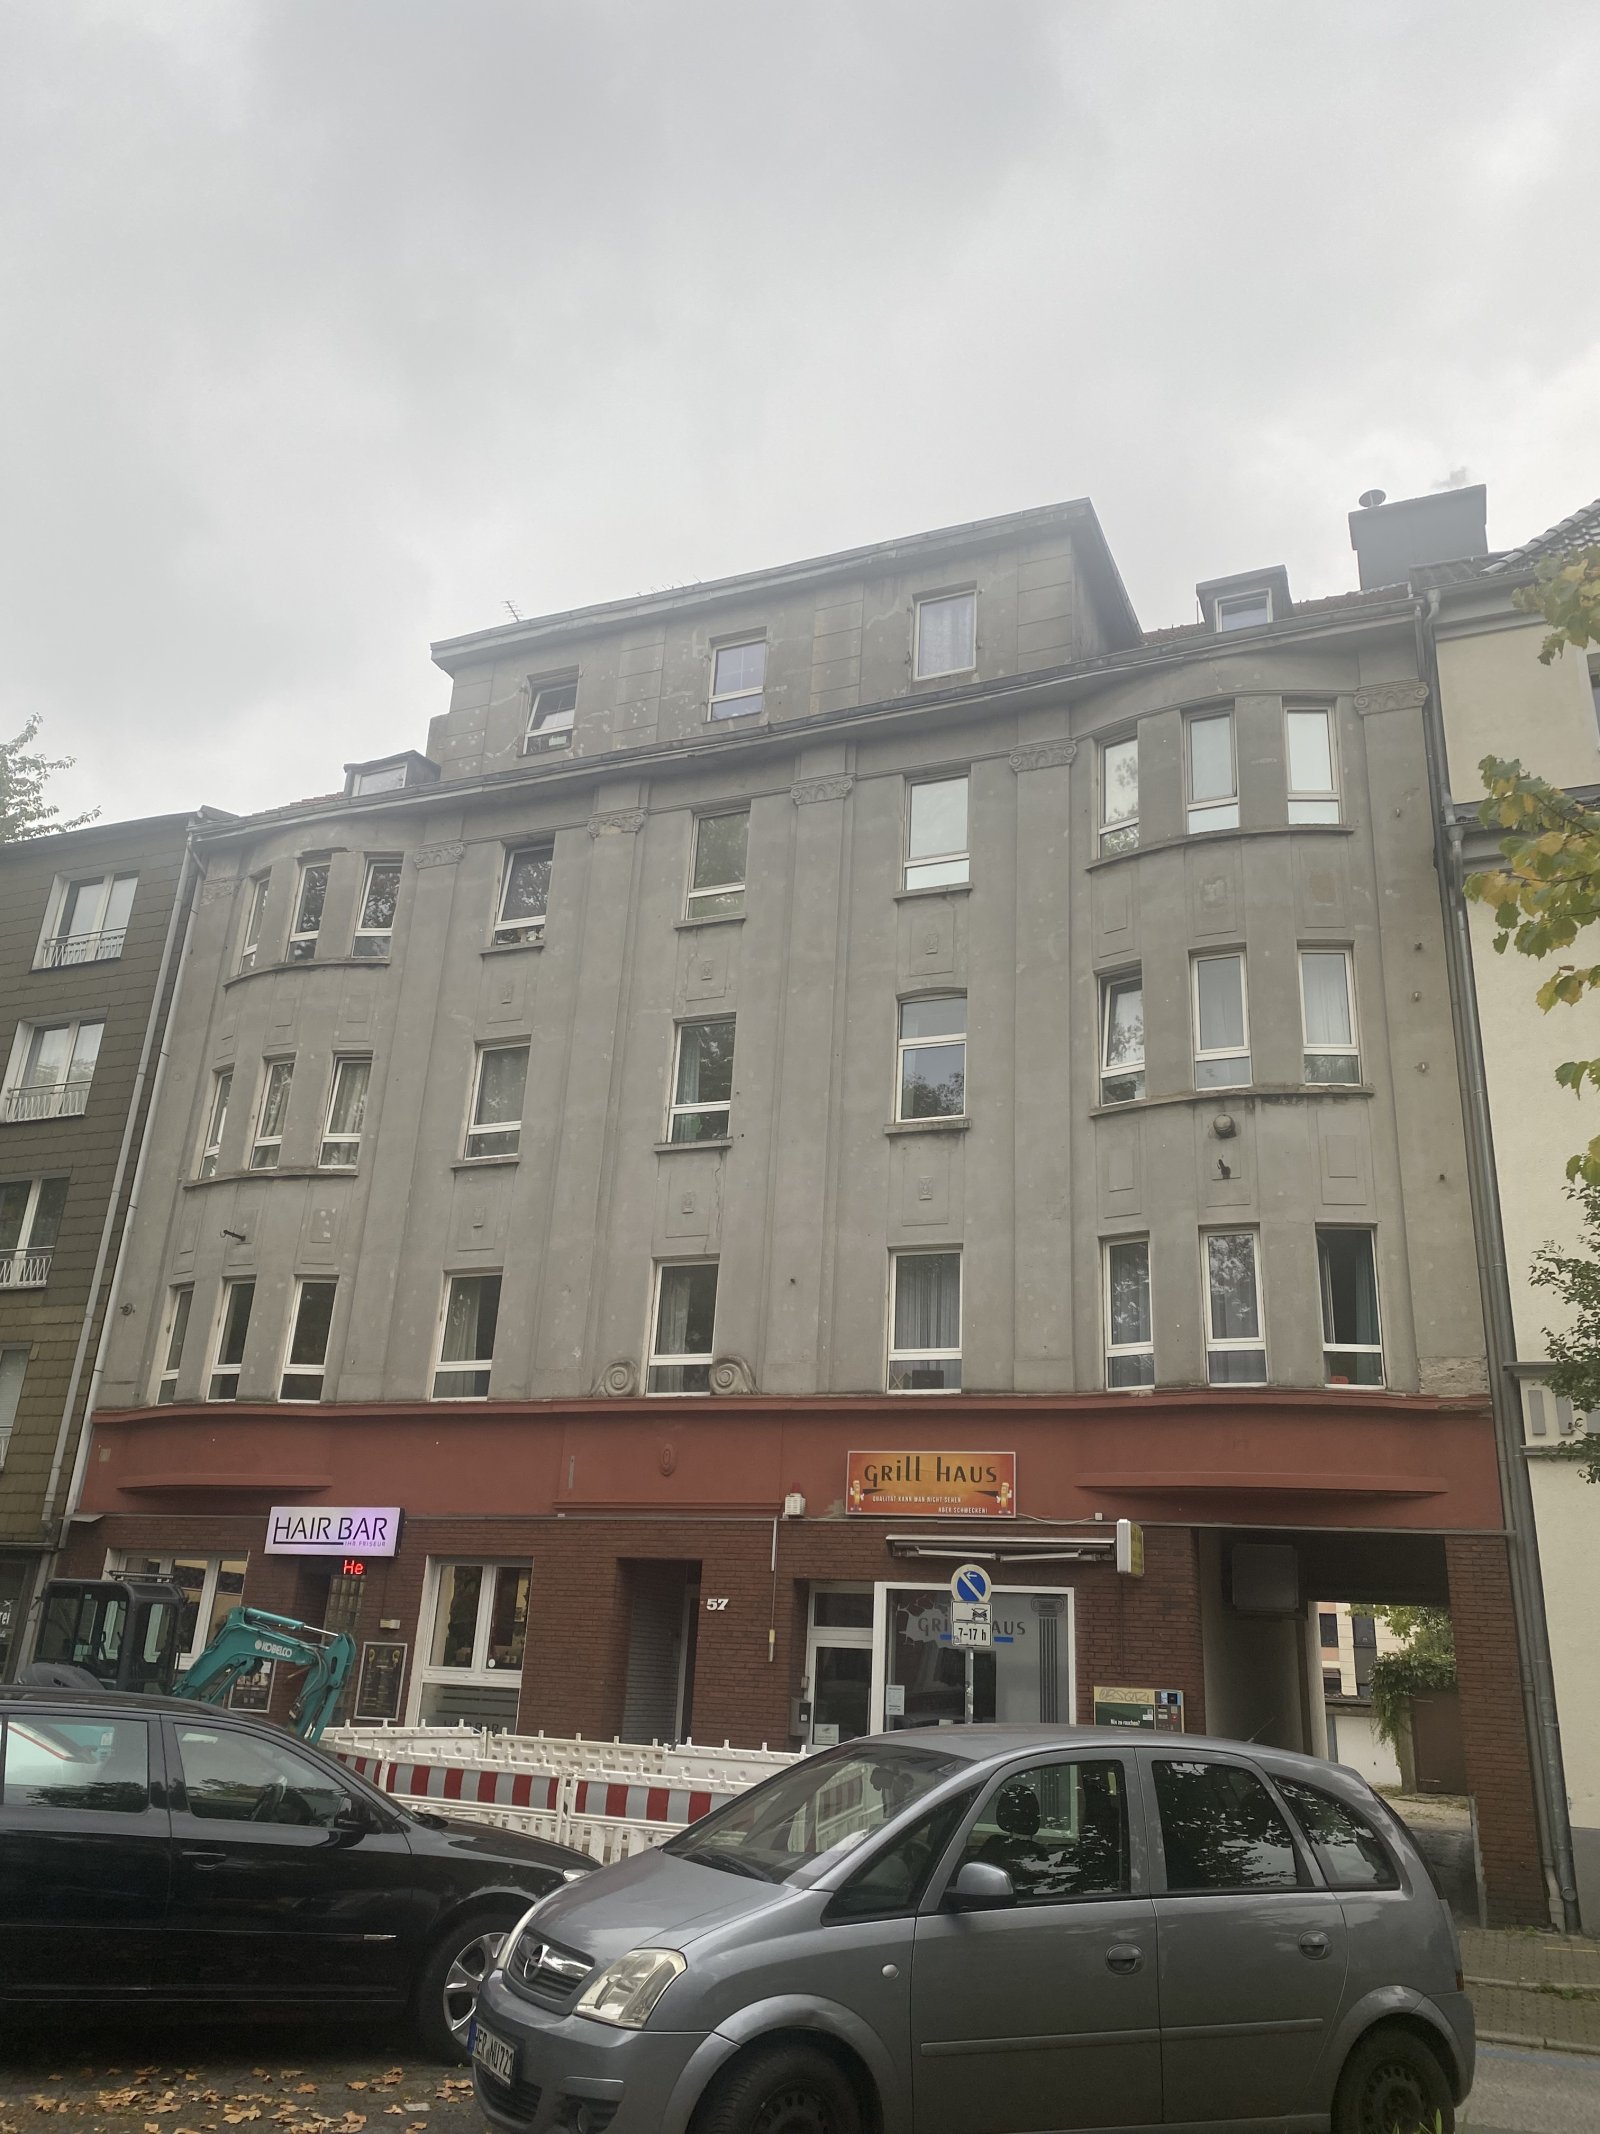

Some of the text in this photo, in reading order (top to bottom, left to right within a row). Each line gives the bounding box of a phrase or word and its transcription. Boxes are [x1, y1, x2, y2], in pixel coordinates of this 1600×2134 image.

[273, 1517, 388, 1544] HAIR BAR
[343, 1560, 364, 1575] He
[706, 1598, 729, 1611] 57
[958, 1627, 987, 1641] 7-17 h
[991, 1620, 1026, 1636] AUS
[262, 1641, 293, 1658] KOBELCO
